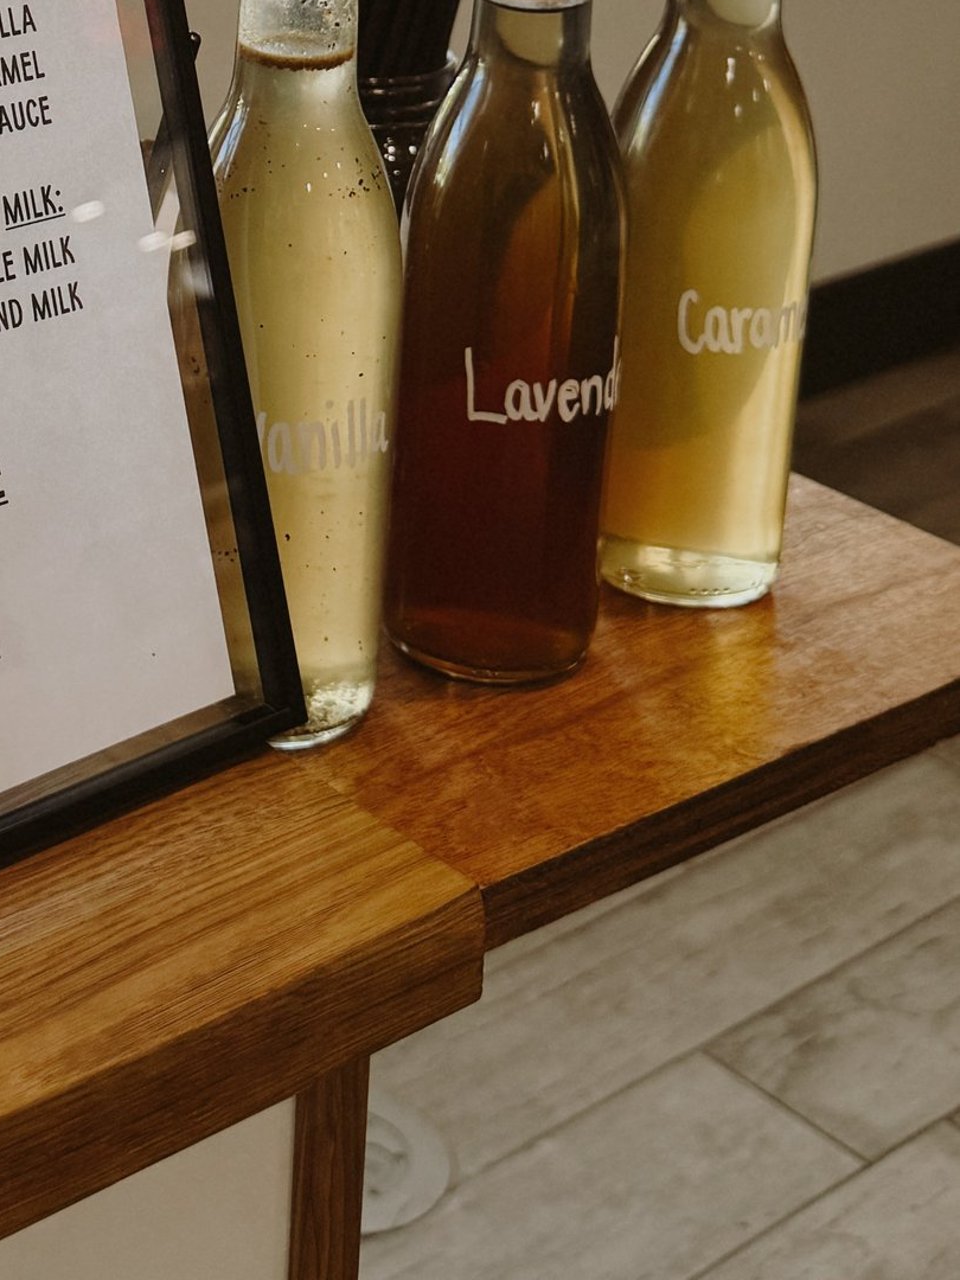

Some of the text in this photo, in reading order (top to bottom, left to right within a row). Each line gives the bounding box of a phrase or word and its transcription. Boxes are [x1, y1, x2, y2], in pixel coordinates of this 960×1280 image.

[2, 185, 63, 225] MILK:
[23, 236, 75, 275] MILK
[31, 281, 83, 322] MILK
[677, 290, 809, 354] Caram
[465, 335, 622, 424] Lavend
